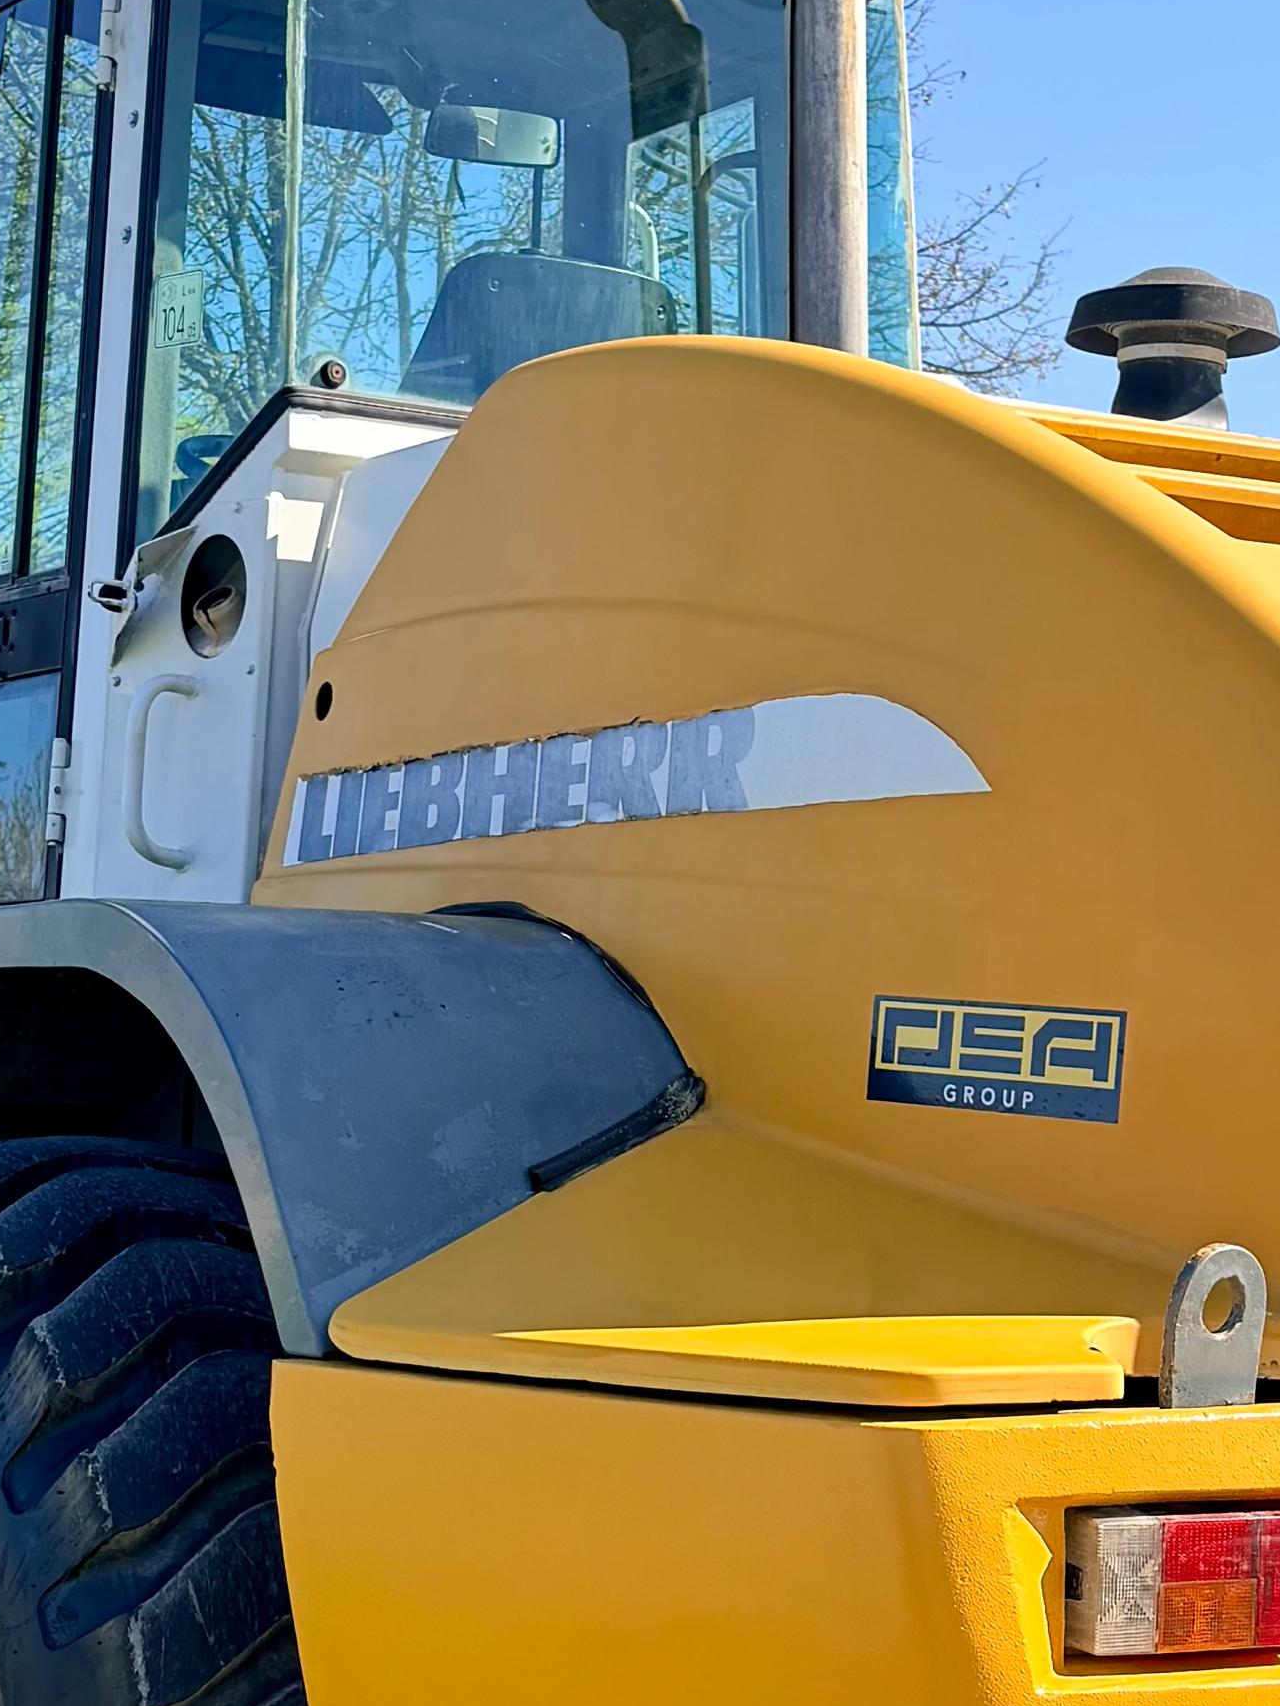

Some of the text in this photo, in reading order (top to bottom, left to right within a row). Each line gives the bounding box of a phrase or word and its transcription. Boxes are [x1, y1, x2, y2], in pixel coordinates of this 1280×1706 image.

[162, 305, 185, 341] 104
[297, 705, 756, 863] LIEBHERR
[943, 1083, 1035, 1110] GROUP
